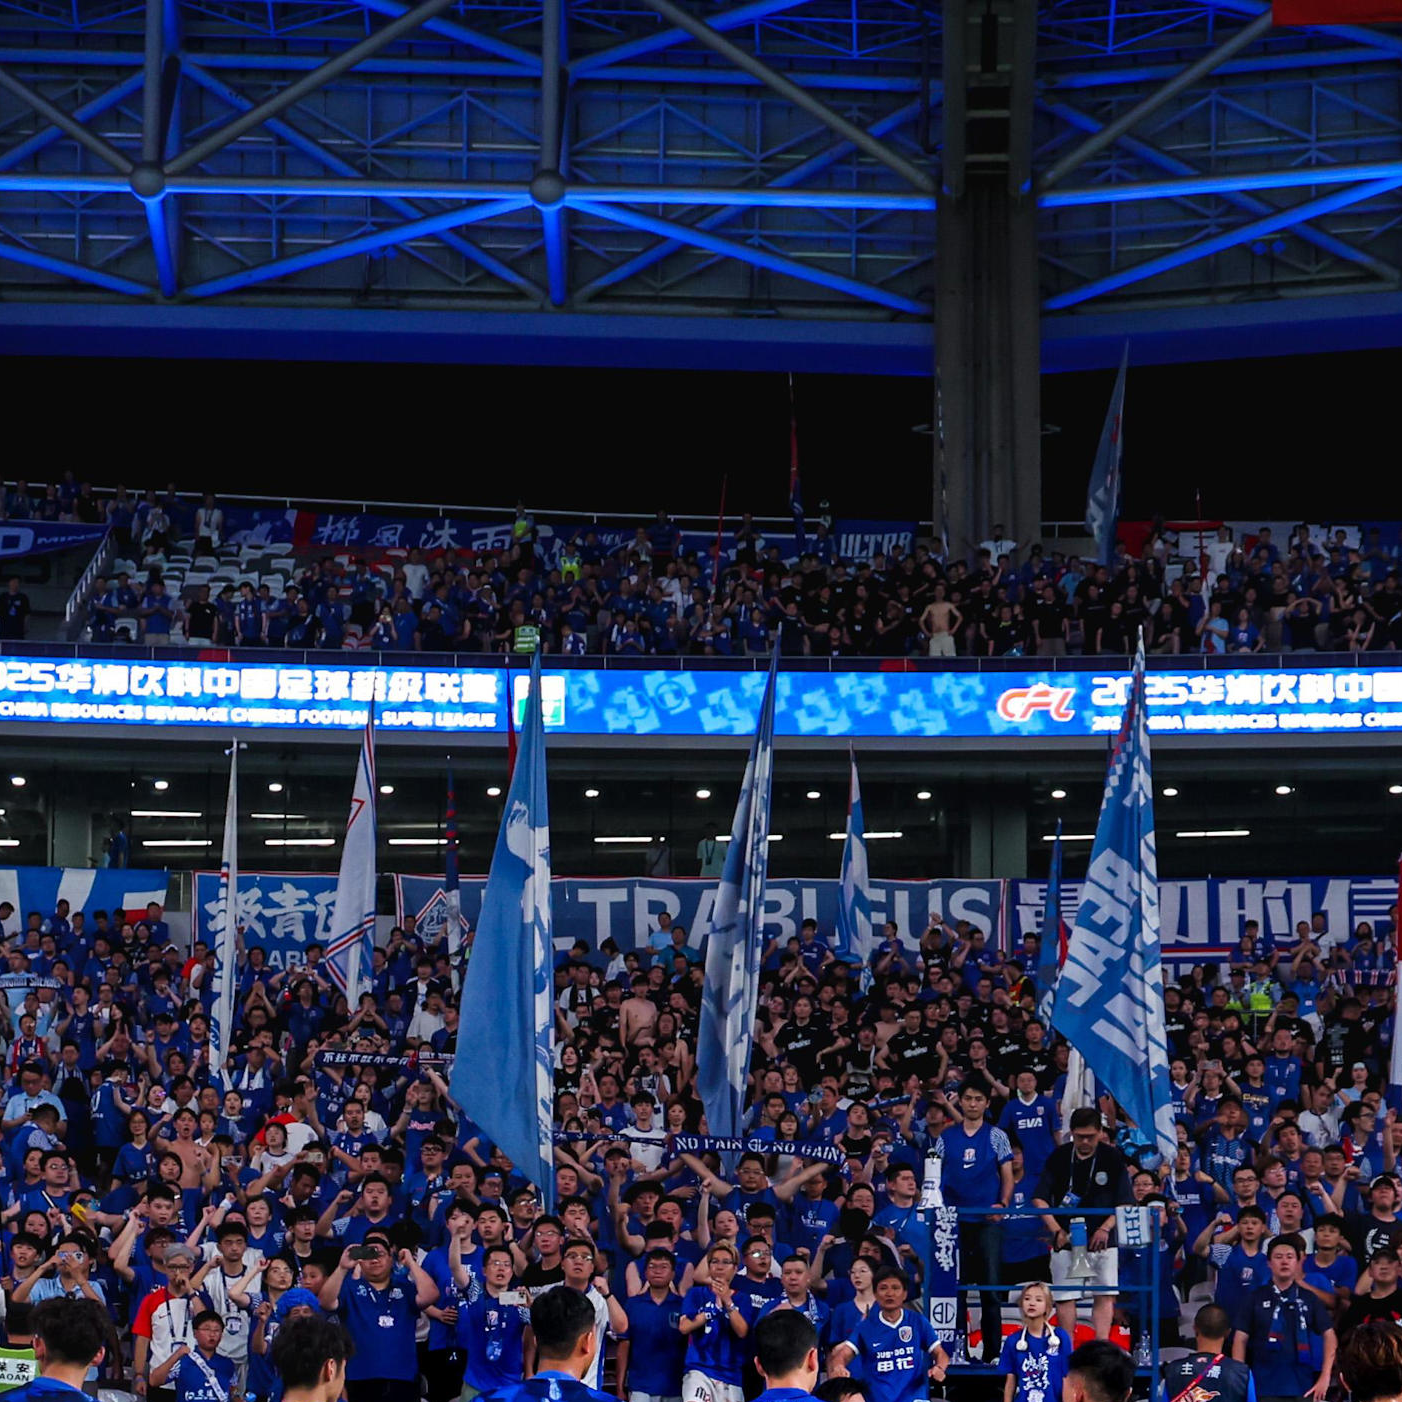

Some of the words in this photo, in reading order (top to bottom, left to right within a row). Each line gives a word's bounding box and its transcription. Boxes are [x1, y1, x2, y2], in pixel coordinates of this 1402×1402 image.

[839, 532, 913, 560] ULTRA
[51, 702, 143, 719] RESOURCES
[146, 705, 228, 722] BEVERAGE
[231, 707, 296, 724] CHINESE
[382, 710, 433, 727] SUPER
[435, 711, 496, 728] LEAGUE
[1017, 1117, 1043, 1129] SVA
[676, 1136, 699, 1150] NO
[772, 1141, 795, 1154] NO
[800, 1142, 840, 1163] GAIN
